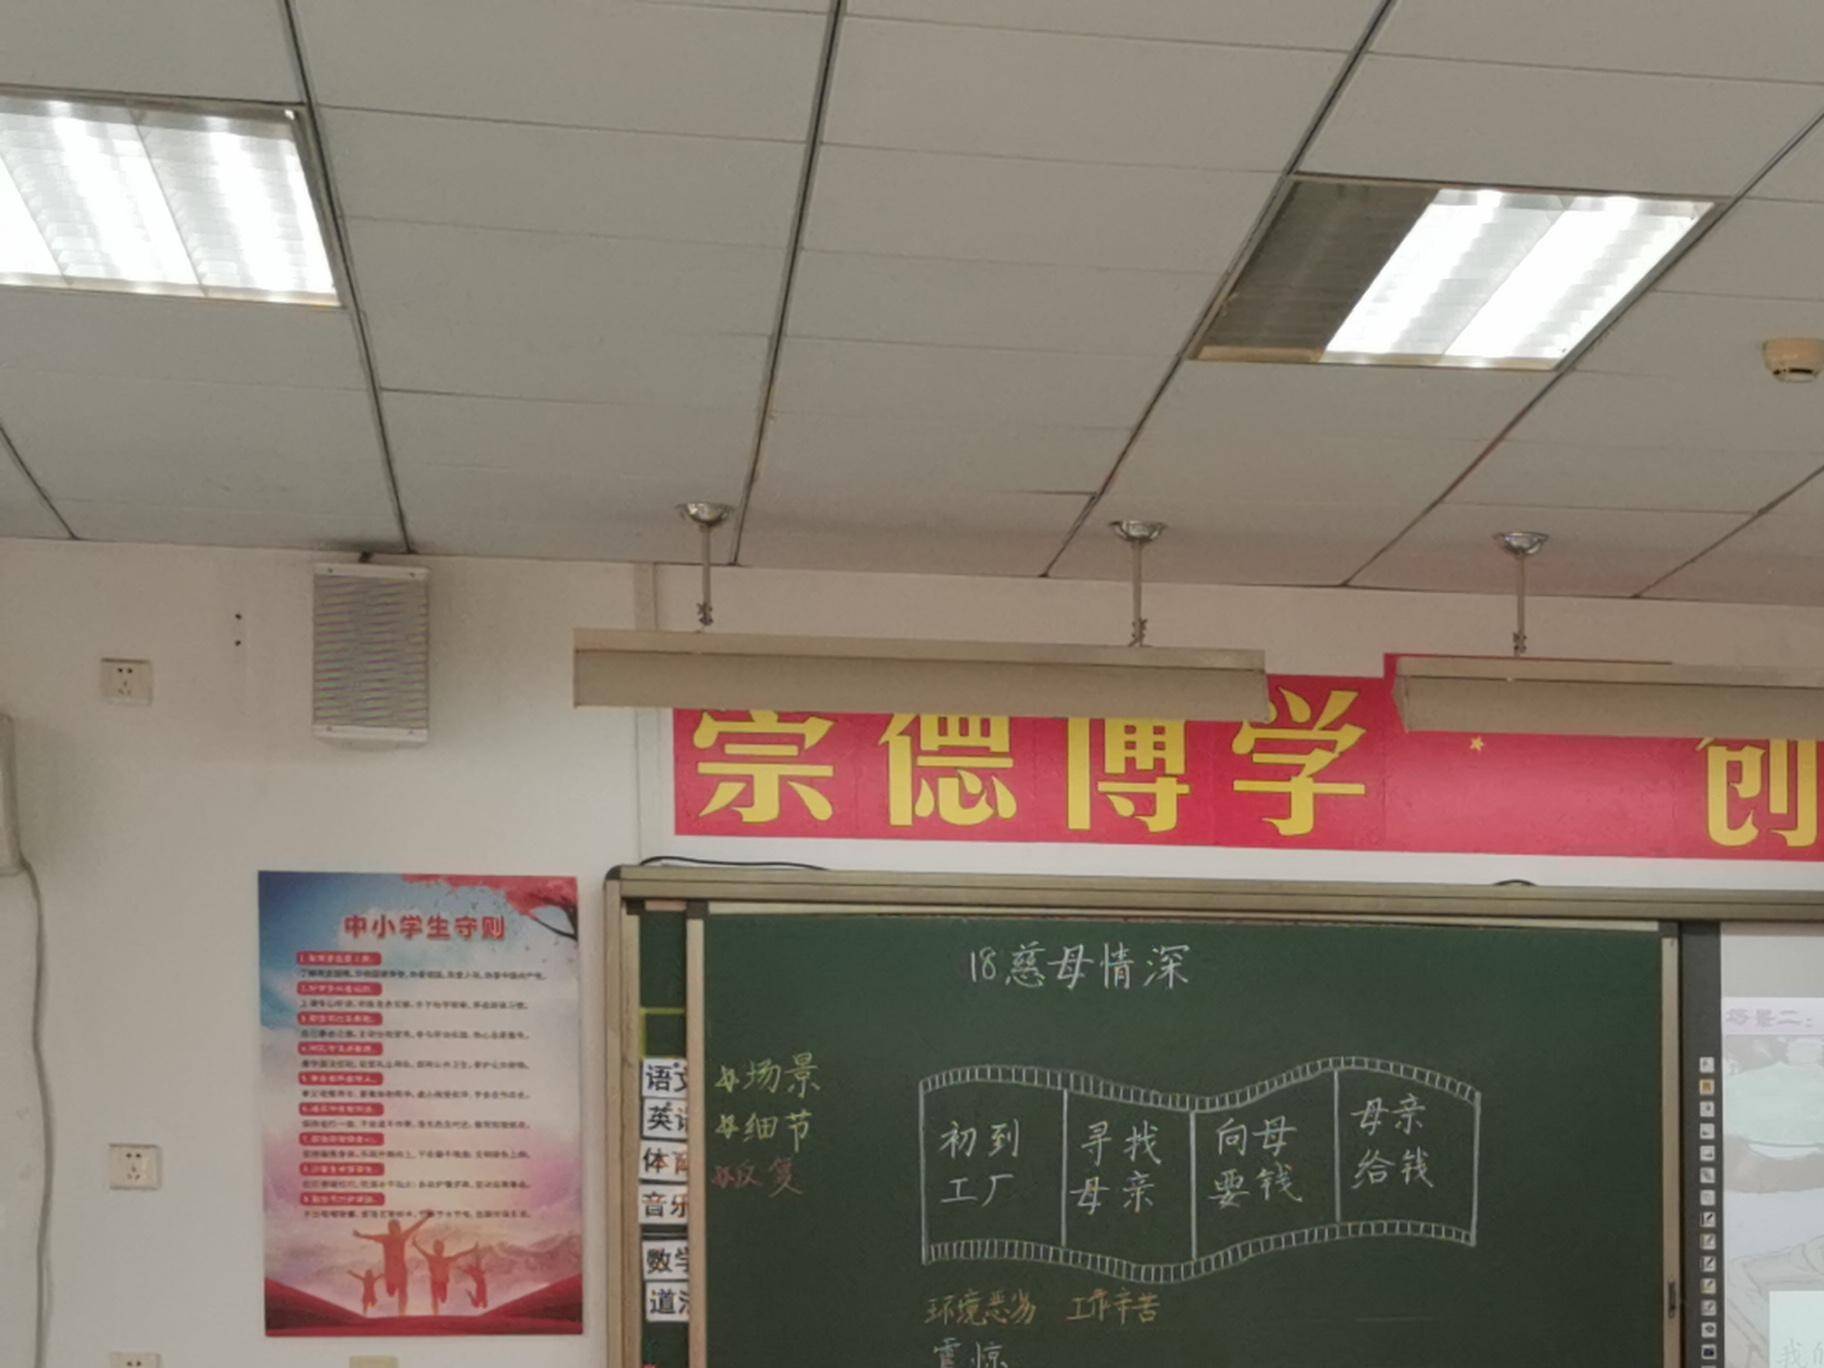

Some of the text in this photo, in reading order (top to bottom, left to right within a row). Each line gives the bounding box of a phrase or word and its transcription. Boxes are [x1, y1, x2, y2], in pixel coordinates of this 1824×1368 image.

[344, 914, 505, 941] 中小学生守则
[970, 941, 1191, 989] 18慈母情深
[1216, 1115, 1297, 1157] 向母
[1351, 1093, 1426, 1136] 母亲
[939, 1118, 1019, 1158] 初到
[1081, 1120, 1161, 1167] 寻找
[1208, 1161, 1302, 1209] 要钱
[1352, 1146, 1434, 1189] 给钱
[941, 1174, 1014, 1207] 工厂
[1070, 1170, 1155, 1215] 母亲
